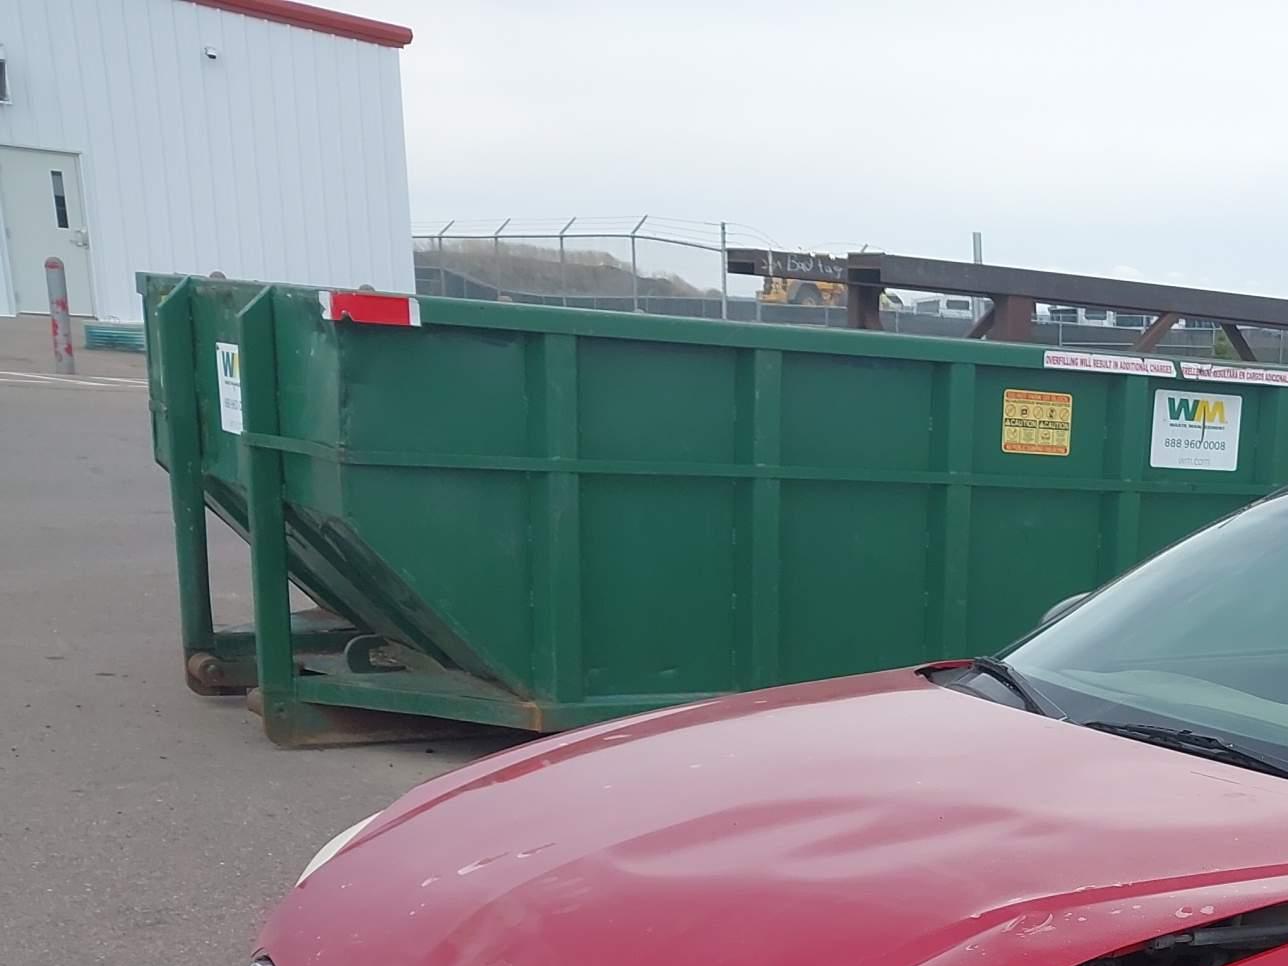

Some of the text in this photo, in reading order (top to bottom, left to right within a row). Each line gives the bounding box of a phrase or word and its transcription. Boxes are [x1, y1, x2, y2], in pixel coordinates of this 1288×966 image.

[1046, 354, 1079, 367] OVERFILLING
[1079, 357, 1092, 368] WILL
[1092, 358, 1113, 369] RESULT
[1119, 361, 1149, 373] ADDITIONAL
[1168, 397, 1226, 425] WM
[1010, 419, 1036, 427] CAUTION
[1164, 438, 1226, 451] 888 960 0008
